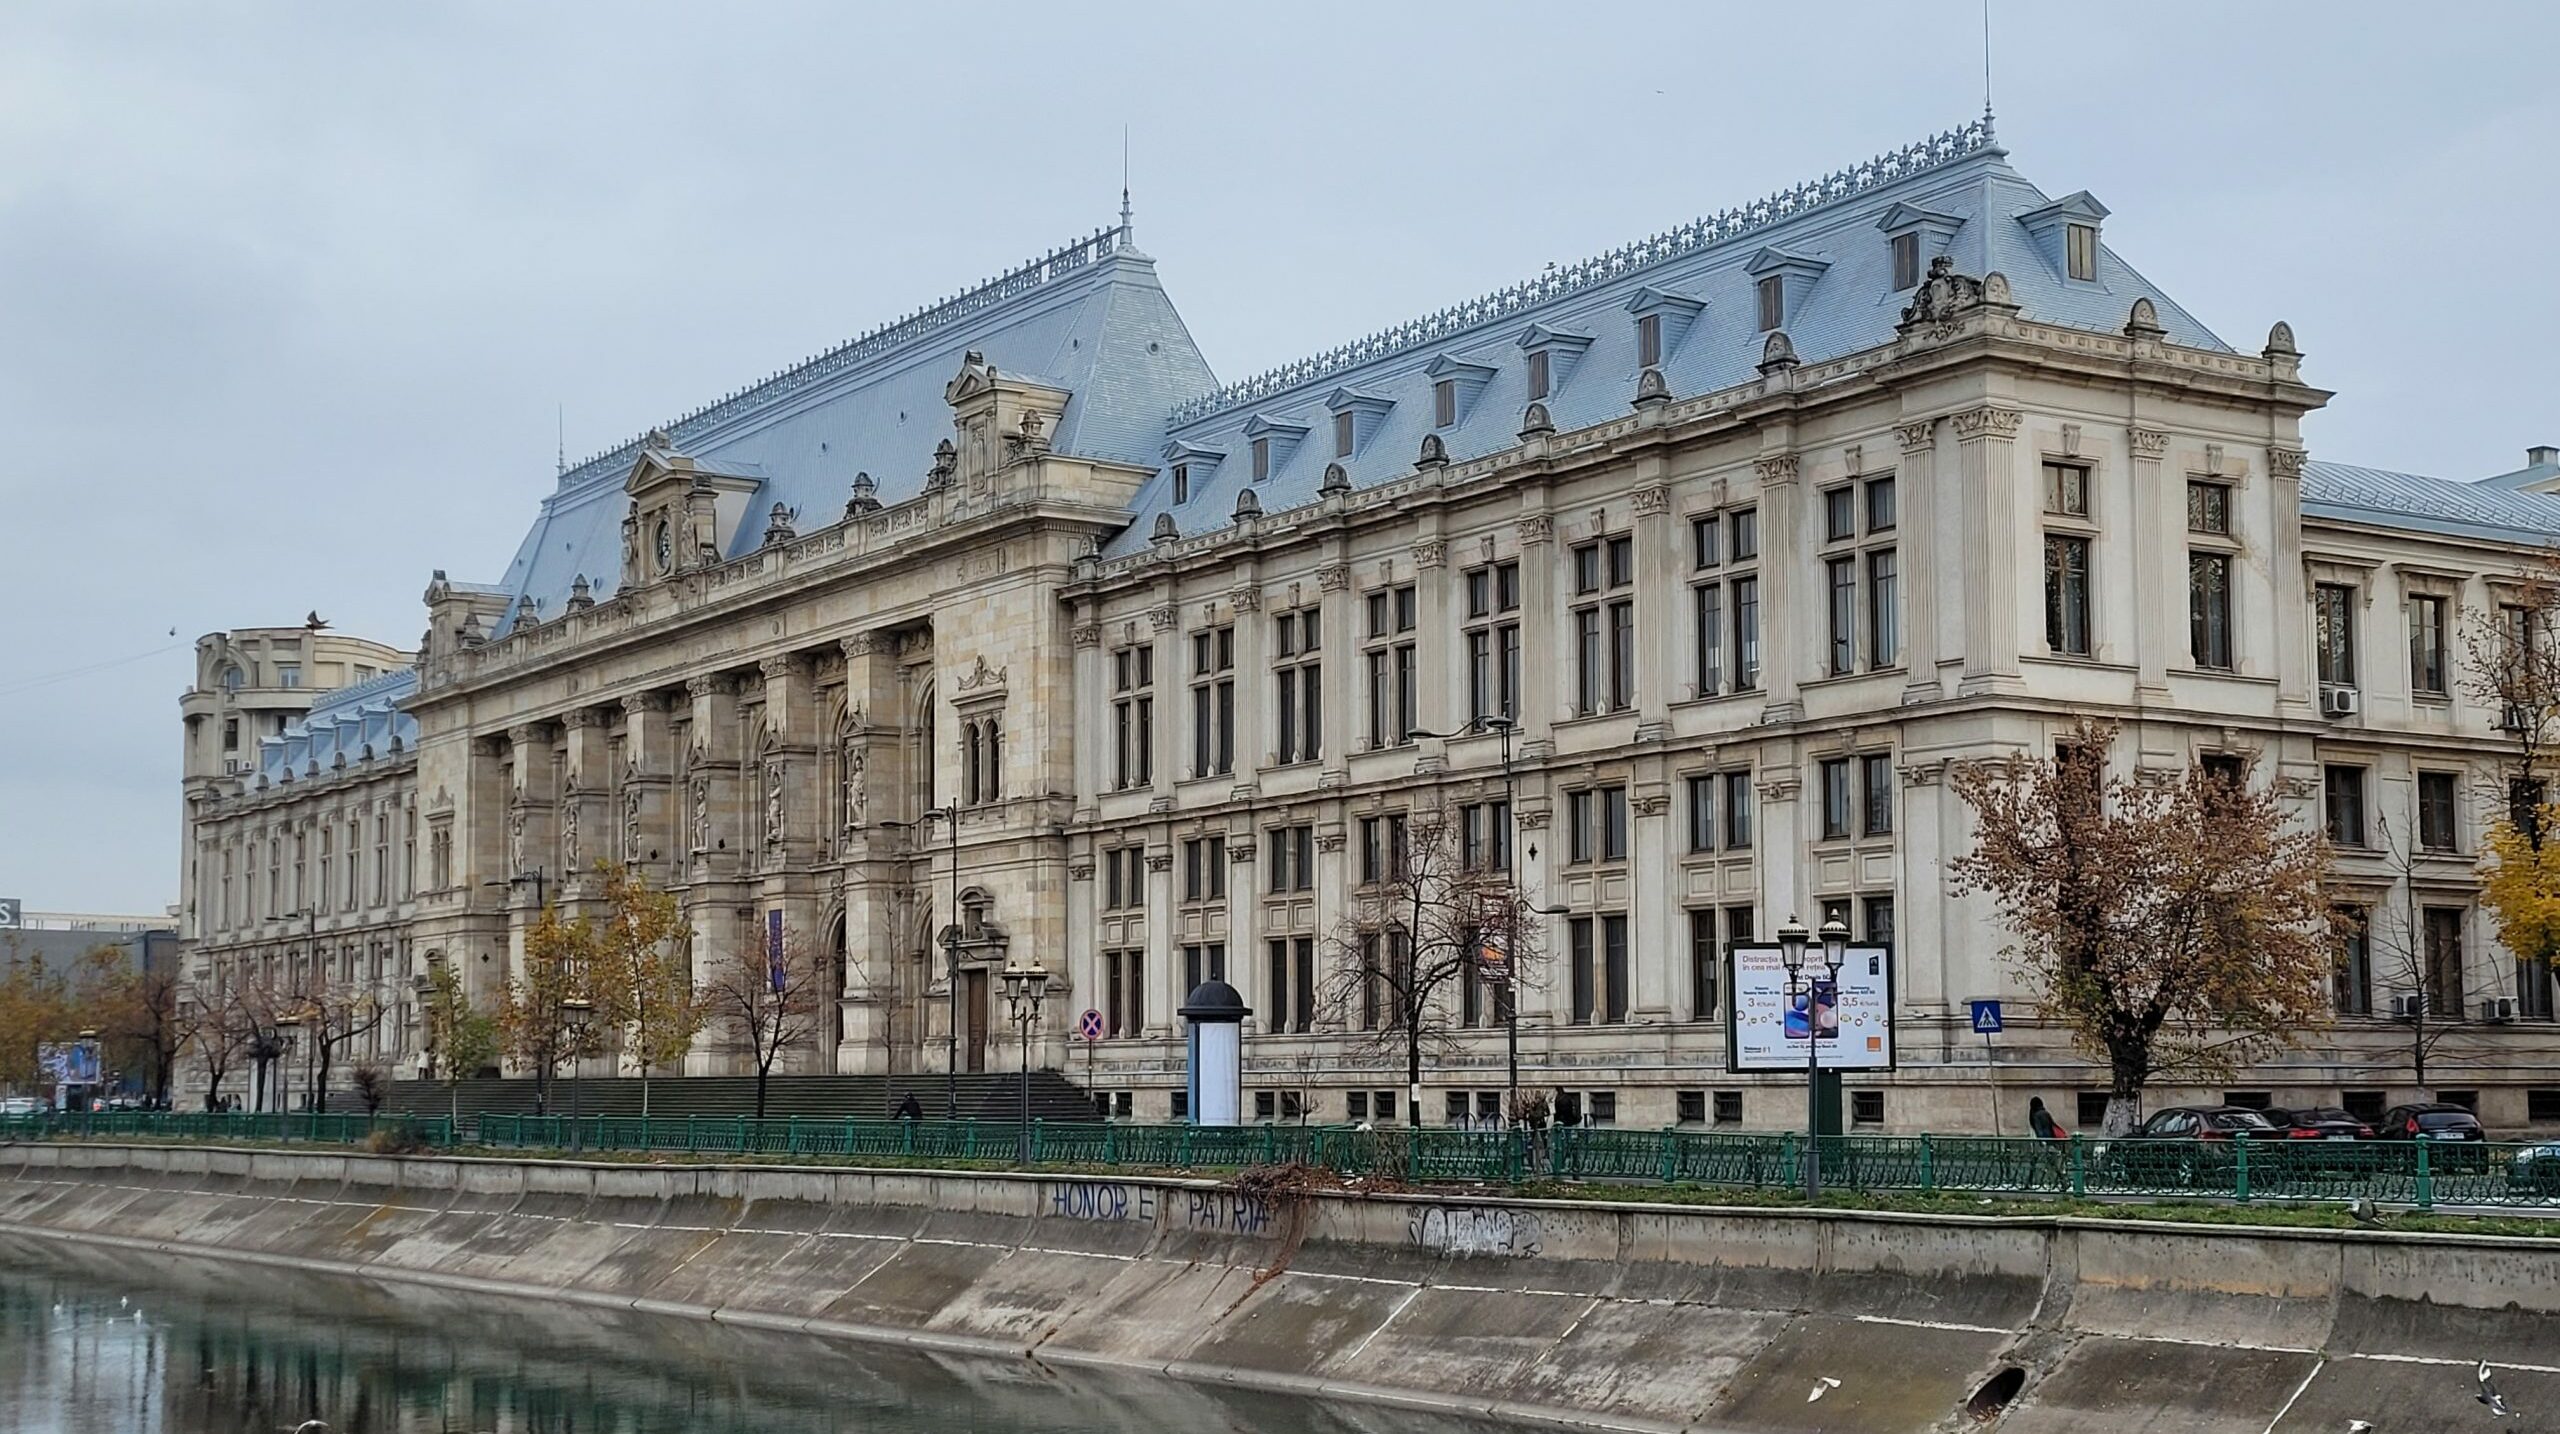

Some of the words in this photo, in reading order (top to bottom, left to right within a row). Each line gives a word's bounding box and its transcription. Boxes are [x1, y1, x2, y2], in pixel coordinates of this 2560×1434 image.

[1748, 997, 1755, 1007] 3
[1842, 997, 1858, 1008] 3,5
[1053, 1183, 1127, 1219] HONOR
[1189, 1190, 1269, 1233] PATRIA
